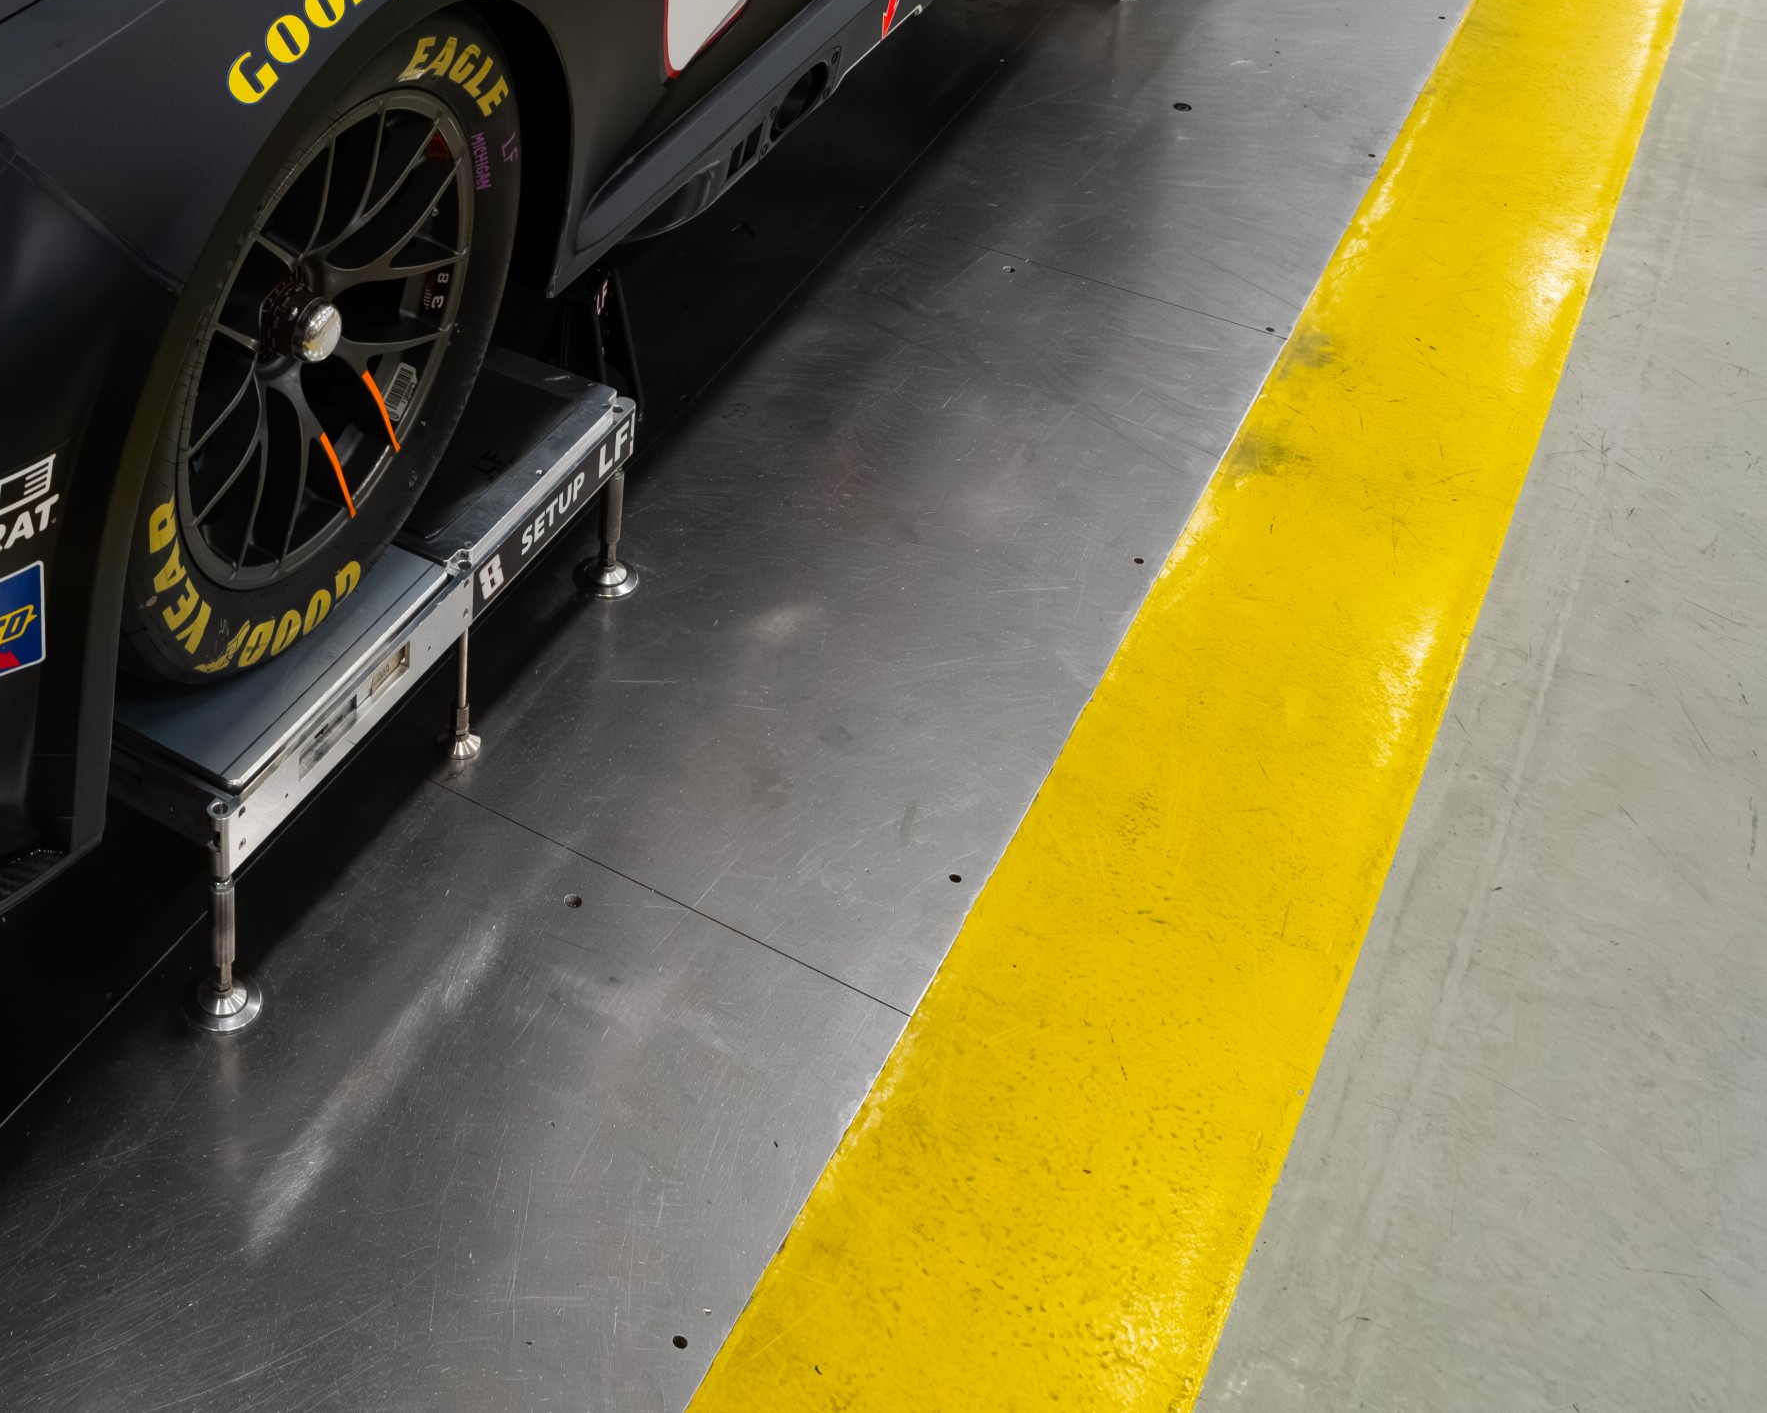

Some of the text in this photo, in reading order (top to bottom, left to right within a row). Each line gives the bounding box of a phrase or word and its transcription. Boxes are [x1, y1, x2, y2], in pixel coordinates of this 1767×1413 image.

[396, 35, 510, 118] EAGLE
[470, 131, 492, 191] MICHIGAN
[478, 419, 630, 601] 8 SETUP LF
